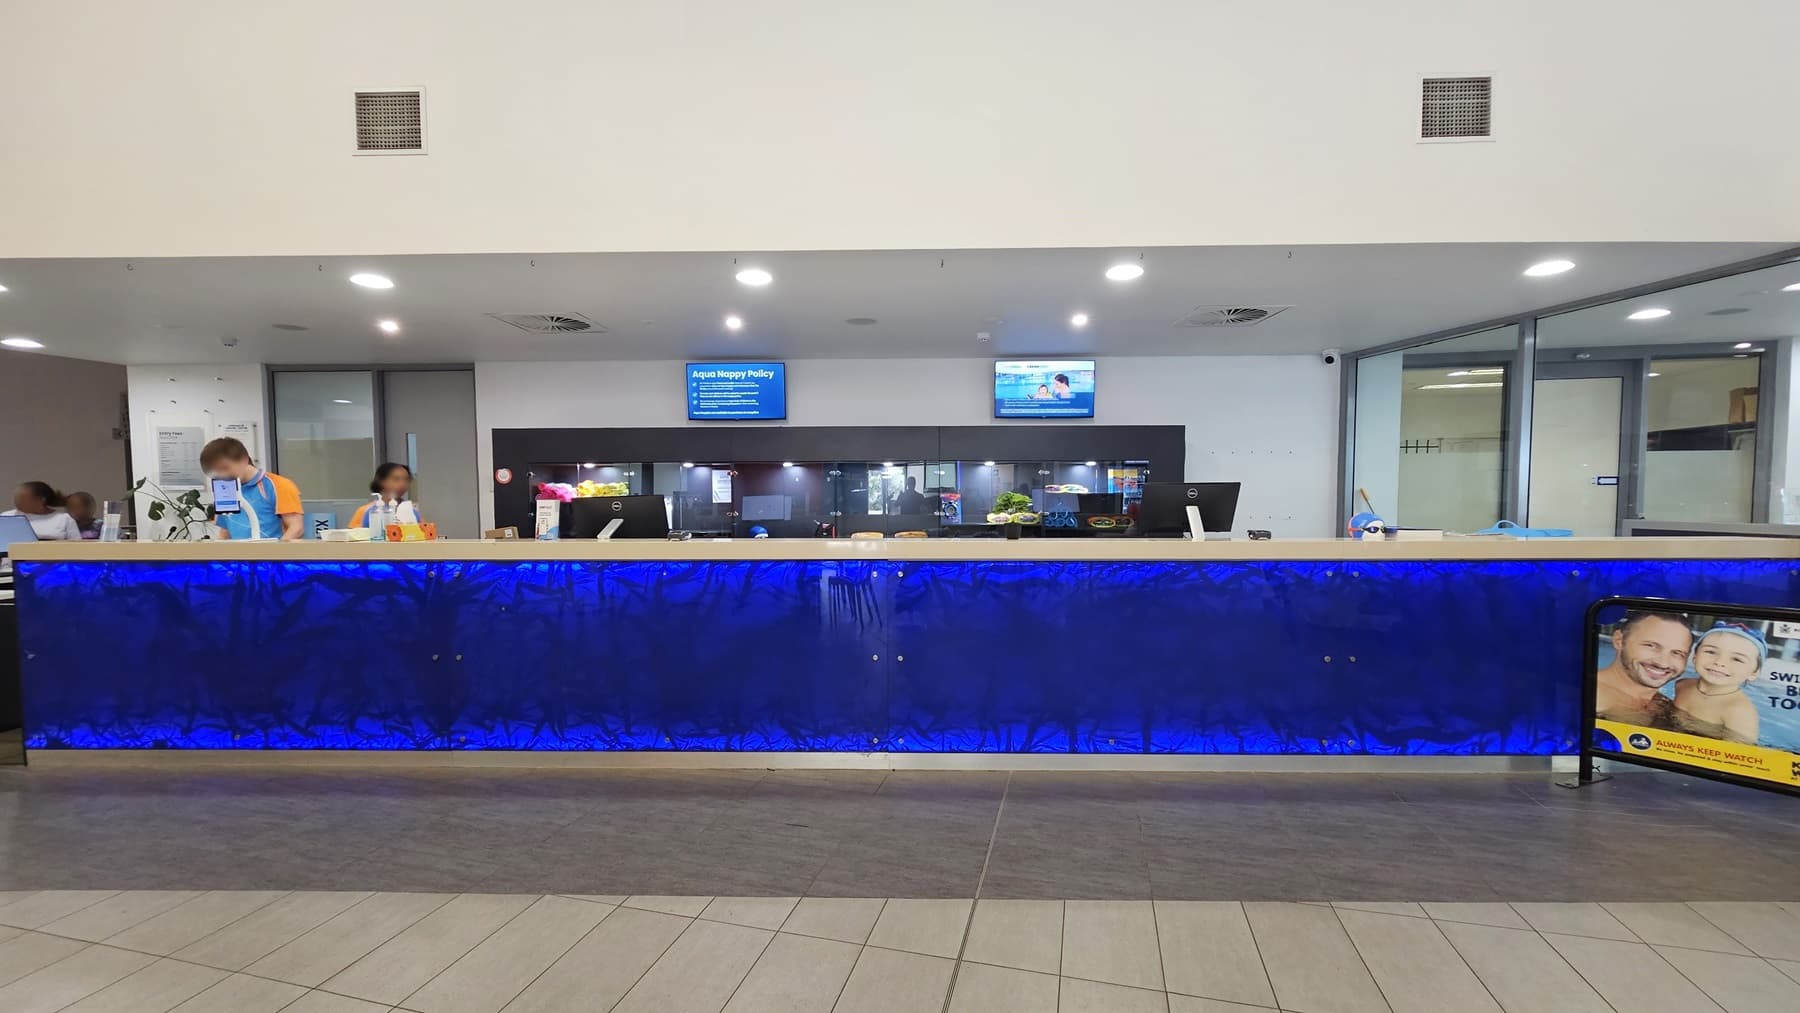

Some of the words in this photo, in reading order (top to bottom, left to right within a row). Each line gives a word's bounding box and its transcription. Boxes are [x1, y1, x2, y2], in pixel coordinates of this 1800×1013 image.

[692, 370, 716, 380] Aqua
[717, 370, 746, 380] Nappy
[747, 369, 774, 380] Policy
[1786, 685, 1800, 697] B
[1768, 696, 1800, 710] TO
[1656, 740, 1694, 752] ALWAYS
[1697, 747, 1721, 757] KEEP
[1725, 752, 1763, 765] WATCH
